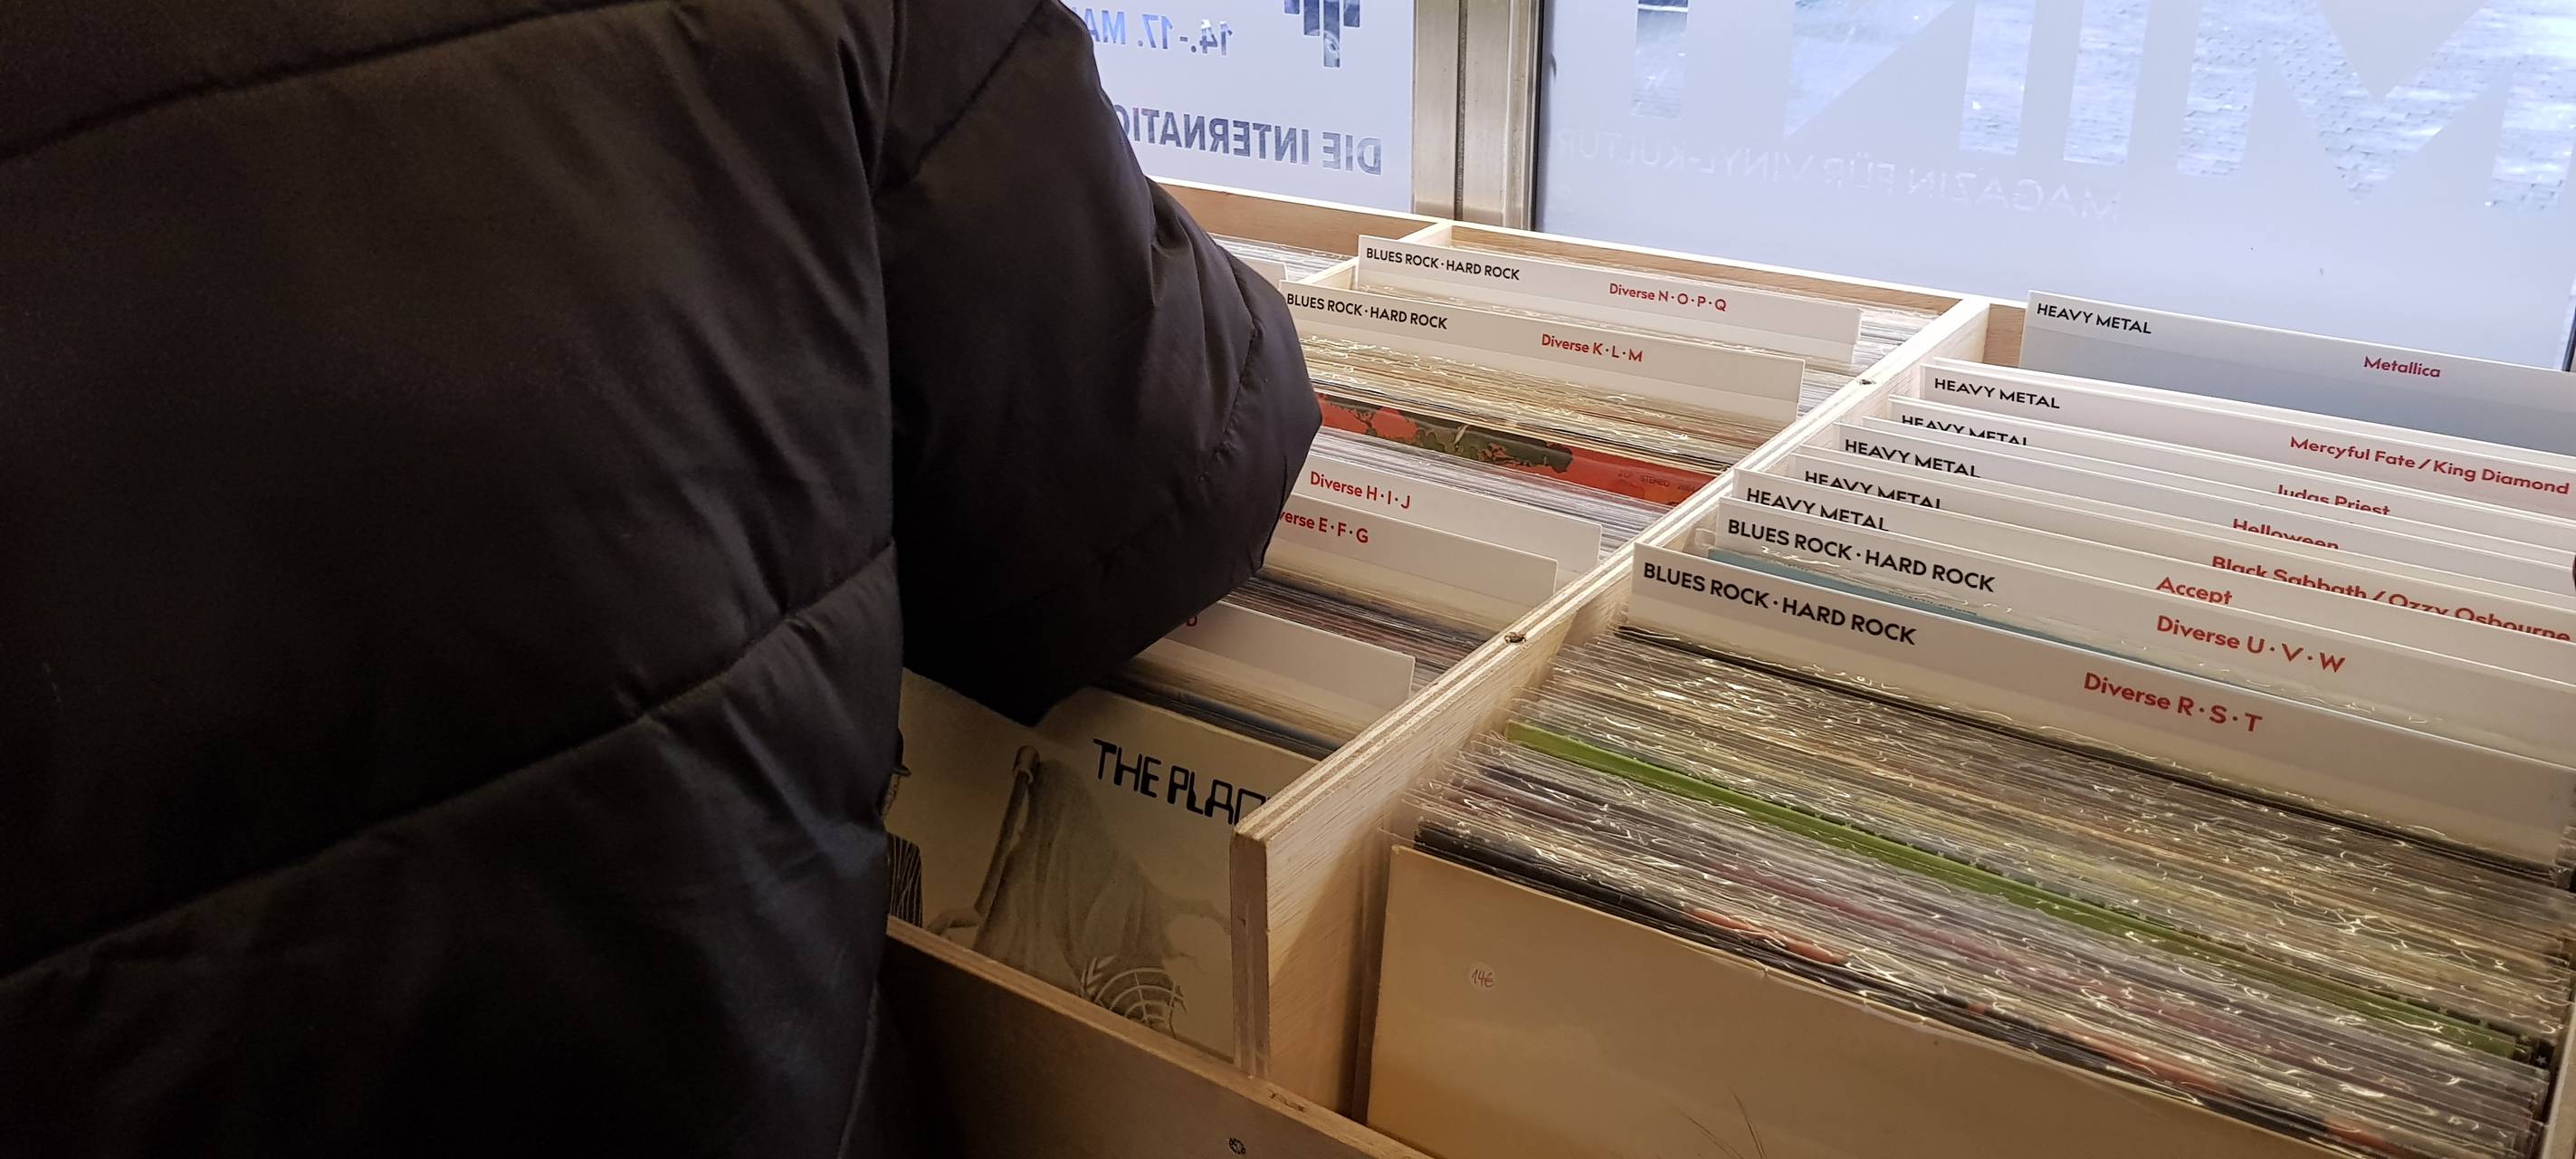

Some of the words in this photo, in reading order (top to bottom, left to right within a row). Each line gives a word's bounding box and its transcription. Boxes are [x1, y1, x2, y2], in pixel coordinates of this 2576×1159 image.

[1366, 247, 1402, 263] BLUES
[1405, 254, 1438, 269] ROCK
[1446, 260, 1482, 275] HARD
[1484, 265, 1520, 281] ROCK
[1609, 283, 1655, 301] Diverse
[1286, 293, 1325, 310] BLUES
[1327, 301, 1362, 316] ROCK
[1370, 307, 1407, 323] HARD
[1410, 313, 1448, 330] ROCK
[2037, 302, 2094, 324] HEAVY
[2096, 315, 2151, 334] METAL
[1541, 333, 1589, 352] Diverse
[2363, 356, 2441, 378] Metallica
[1934, 378, 1996, 398] HEAVY
[1999, 389, 2060, 409] METAL
[1902, 415, 1965, 434] HEAVY
[1845, 438, 1910, 464] HEAVY
[1914, 454, 1980, 478] METAL
[2290, 436, 2371, 460] Mercyful
[2374, 450, 2416, 469] Fate
[2433, 460, 2476, 483] King
[2481, 468, 2571, 495] Diamond
[1311, 471, 1362, 497] Diverse
[1805, 470, 1874, 494] HEAVY
[1877, 486, 1941, 510] METAL
[1746, 487, 1817, 515] HEAVY
[1820, 504, 1889, 532] METAL
[2334, 494, 2390, 516] Priest
[1728, 519, 1789, 547] BLUES
[1794, 533, 1853, 560] ROCK
[1865, 550, 1927, 576] HARD
[1932, 564, 1996, 593] ROCK
[1644, 562, 1706, 592] BLUES
[1710, 582, 1770, 609] ROCK
[1782, 598, 1846, 627] HARD
[1851, 615, 1916, 647] ROCK
[2155, 576, 2233, 606] Accept
[2211, 555, 2268, 579] Black
[2273, 569, 2367, 600] Sabbath
[2455, 607, 2571, 642] Osbourne
[2157, 615, 2240, 649] Diverse
[2084, 672, 2171, 711] Diverse
[1093, 739, 1161, 798] THE
[1167, 765, 1271, 825] PLA
[1471, 968, 1495, 988] 14€
